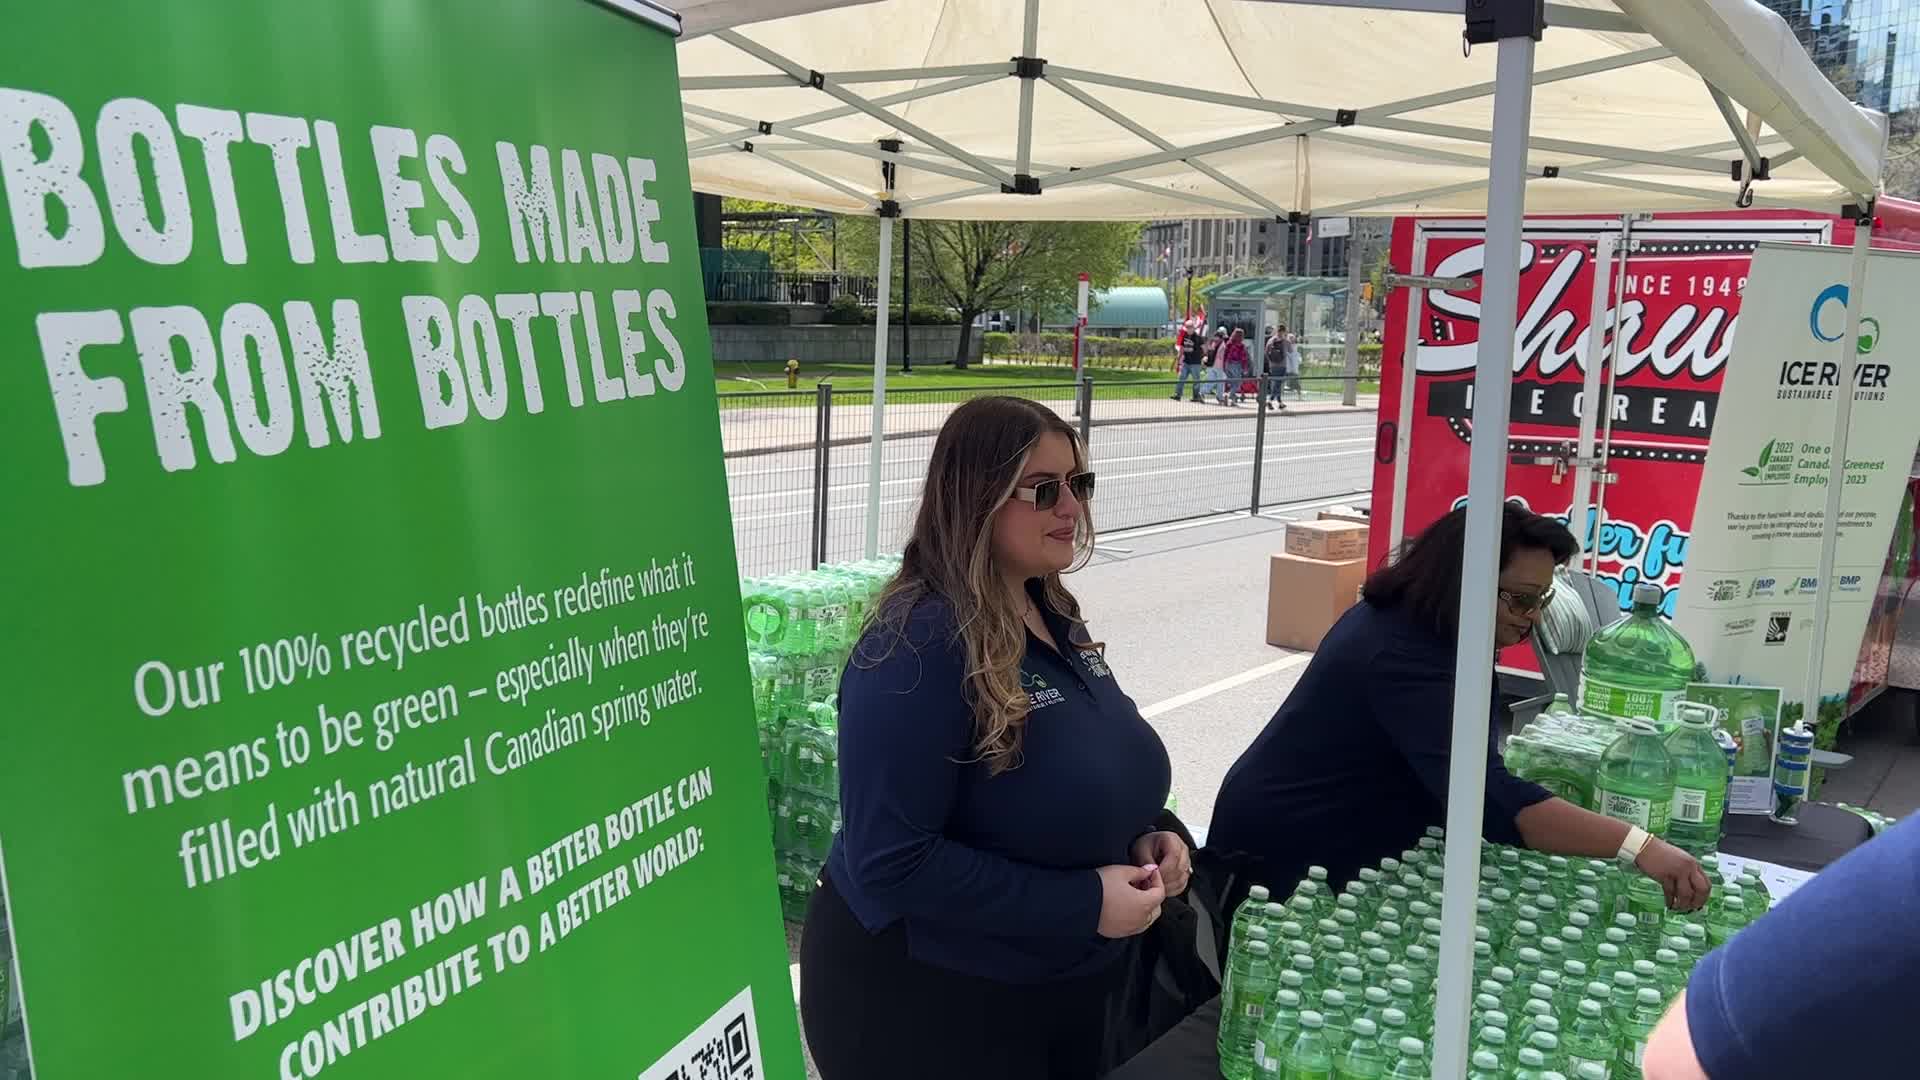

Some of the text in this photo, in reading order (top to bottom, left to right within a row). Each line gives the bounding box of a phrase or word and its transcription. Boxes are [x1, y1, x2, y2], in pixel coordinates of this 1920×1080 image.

[0, 88, 669, 268] BOTTLES MADE
[1614, 275, 1672, 295] INCE
[1780, 361, 1817, 386] ICE
[36, 289, 685, 486] FROM BOTTLES
[1464, 385, 1544, 415] IE
[1777, 389, 1885, 401] SUSTAINABLE UTIONS
[1801, 443, 1831, 455] One o
[1798, 459, 1885, 470] Canad Greenest
[1794, 474, 1867, 487] Employ 2023
[1800, 578, 1817, 588] BM
[1839, 576, 1861, 585] BMP
[135, 553, 696, 716] Our 100% recycled bottles redefine what it
[1035, 688, 1062, 701] RIVER
[123, 737, 270, 814] means
[275, 712, 311, 768] to
[319, 704, 364, 755] be
[374, 682, 459, 752] green
[495, 637, 594, 707] especially
[599, 626, 651, 668] when
[652, 609, 709, 658] they're
[178, 667, 703, 889] filled with natural Canadian spring water.
[229, 766, 714, 1042] DISCOVER HOW A BETTER BOTTLE CAN
[279, 826, 705, 1080] CONTRIBUTE TO A BETTER WORLD:
